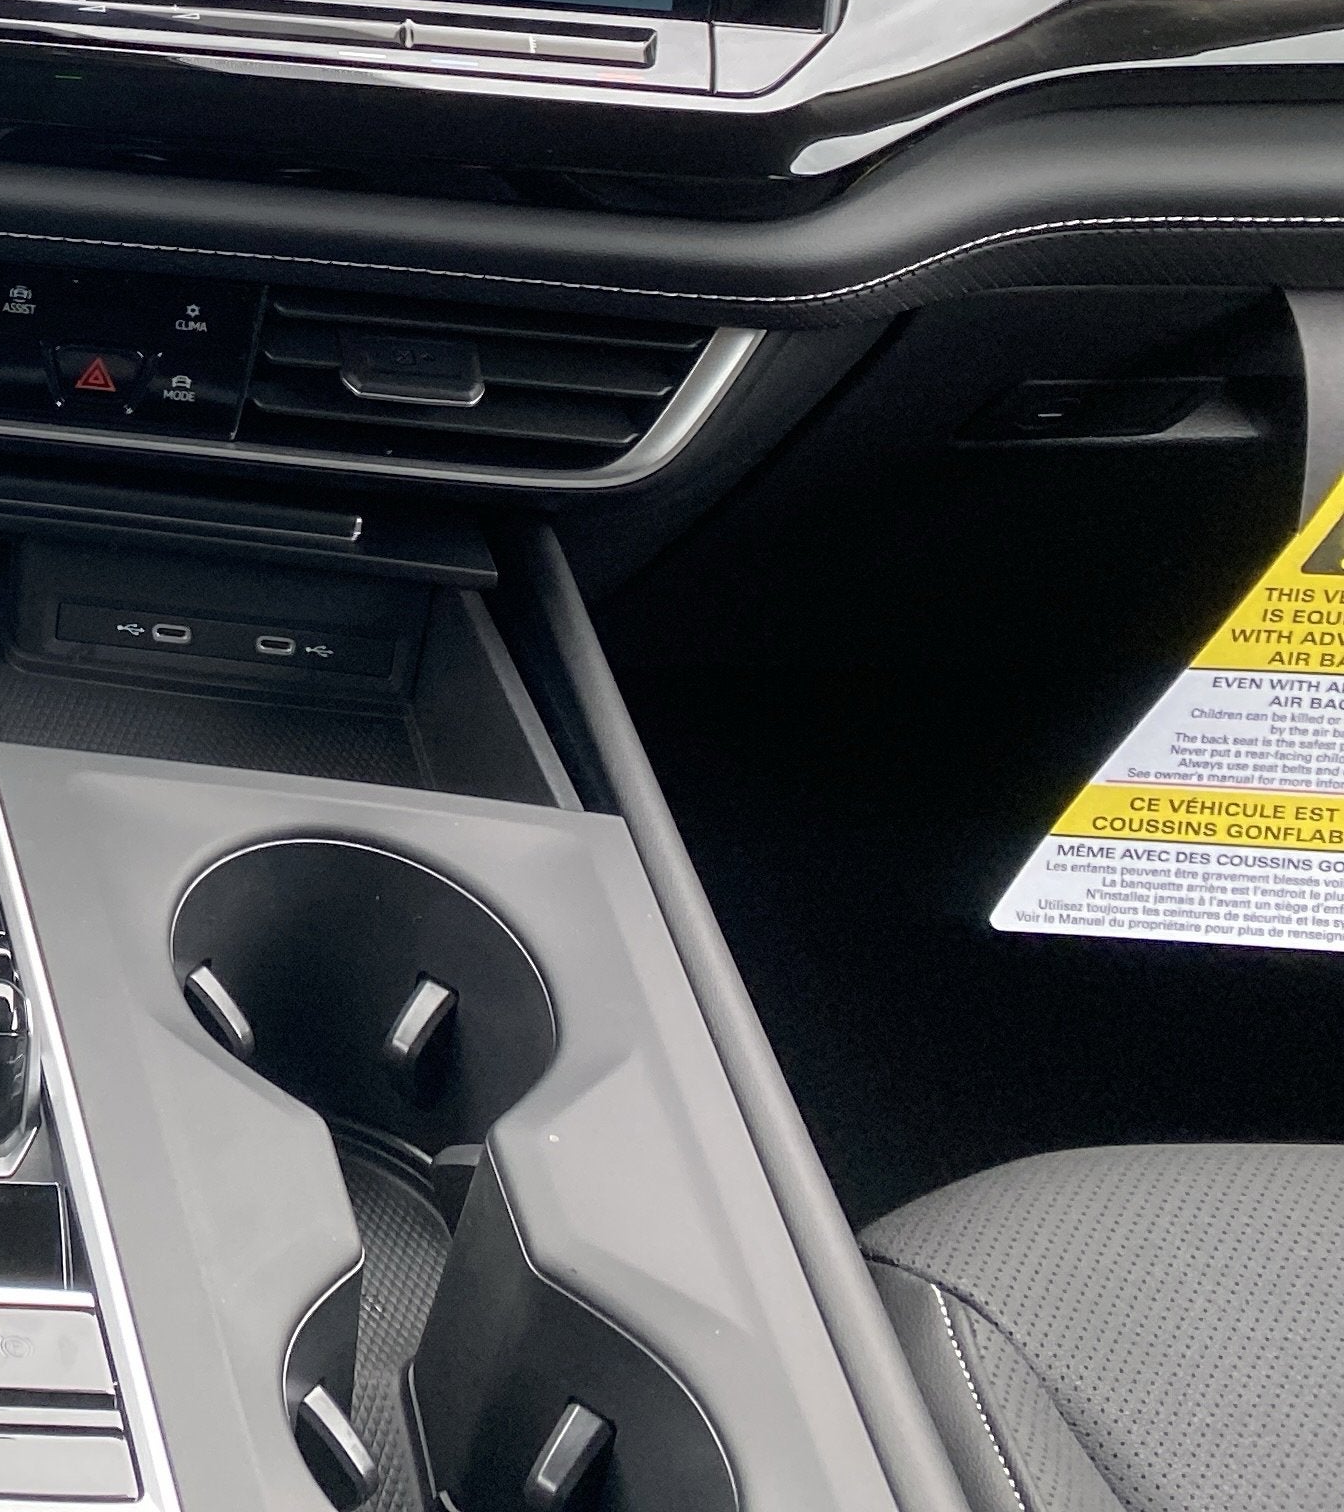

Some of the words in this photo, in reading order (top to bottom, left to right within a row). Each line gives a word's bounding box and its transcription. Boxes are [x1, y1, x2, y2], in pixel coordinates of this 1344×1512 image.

[2, 303, 37, 315] ASSIST
[175, 320, 208, 333] CLIMA
[163, 390, 196, 402] MODE
[1264, 588, 1315, 603] THIS
[1261, 608, 1284, 623] IS
[1292, 610, 1344, 625] EQU
[1231, 629, 1293, 644] WITH
[1267, 651, 1312, 666] AIR
[1212, 677, 1263, 690] EVEN
[1269, 679, 1320, 693] WITH
[1268, 695, 1302, 708] AIR
[1191, 708, 1243, 720] Children
[1246, 713, 1269, 721] can
[1272, 712, 1288, 723] be
[1290, 713, 1324, 724] killed
[1327, 716, 1341, 725] or
[1270, 724, 1286, 737] by
[1289, 726, 1309, 736] the
[1312, 728, 1330, 737] air
[1175, 732, 1198, 743] The
[1201, 733, 1229, 745] back
[1232, 736, 1258, 746] seat
[1262, 736, 1273, 746] is
[1276, 738, 1297, 748] the
[1298, 739, 1336, 750] safest
[1170, 745, 1208, 756] Never
[1210, 748, 1231, 758] put
[1234, 750, 1241, 758] a
[1245, 750, 1312, 764] rear-facing
[1178, 758, 1223, 771] Always
[1227, 763, 1249, 771] use
[1252, 764, 1278, 773] seat
[1282, 764, 1312, 774] belts
[1315, 766, 1340, 776] and
[1127, 767, 1151, 778] See
[1154, 771, 1204, 781] owner's
[1207, 773, 1254, 784] manual
[1258, 774, 1275, 785] for
[1279, 778, 1312, 787] more
[1129, 797, 1160, 812] CE
[1168, 797, 1286, 820] VÉHICULE
[1294, 806, 1340, 822] EST
[1092, 816, 1217, 837] COUSSINS
[1057, 844, 1116, 859] MÊME
[1120, 848, 1170, 862] AVEC
[1175, 852, 1211, 864] DES
[1216, 854, 1312, 871] COUSSINS
[1046, 860, 1067, 872] Les
[1071, 863, 1118, 874] enfants
[1121, 866, 1171, 879] peuvent
[1175, 868, 1199, 879] être
[1202, 871, 1270, 884] gravement
[1273, 874, 1320, 887] blessés
[1102, 876, 1116, 887] La
[1120, 877, 1183, 892] banquette
[1186, 882, 1227, 894] arrière
[1231, 886, 1249, 896] est
[1253, 886, 1306, 899] l'endroit
[1310, 889, 1321, 899] le
[1153, 891, 1195, 906] jamais
[1198, 896, 1205, 906] à
[1209, 896, 1251, 908] l'avant
[1255, 901, 1271, 910] un
[1274, 900, 1308, 914] siège
[1038, 899, 1083, 912] Utilisez
[1087, 903, 1139, 916] toujours
[1142, 905, 1160, 917] les
[1163, 907, 1220, 921] ceintures
[1224, 910, 1239, 922] de
[1243, 911, 1293, 925] sécurité
[1296, 915, 1308, 926] et
[1312, 916, 1330, 928] les
[1016, 910, 1041, 923] Voir
[1044, 913, 1055, 924] le
[1058, 914, 1105, 927] Manuel
[1109, 916, 1125, 928] du
[1128, 918, 1201, 933] propriétaire
[1204, 924, 1235, 935] pour
[1237, 925, 1265, 937] plus
[1268, 927, 1284, 938] de
[1287, 929, 1344, 943] renseign
